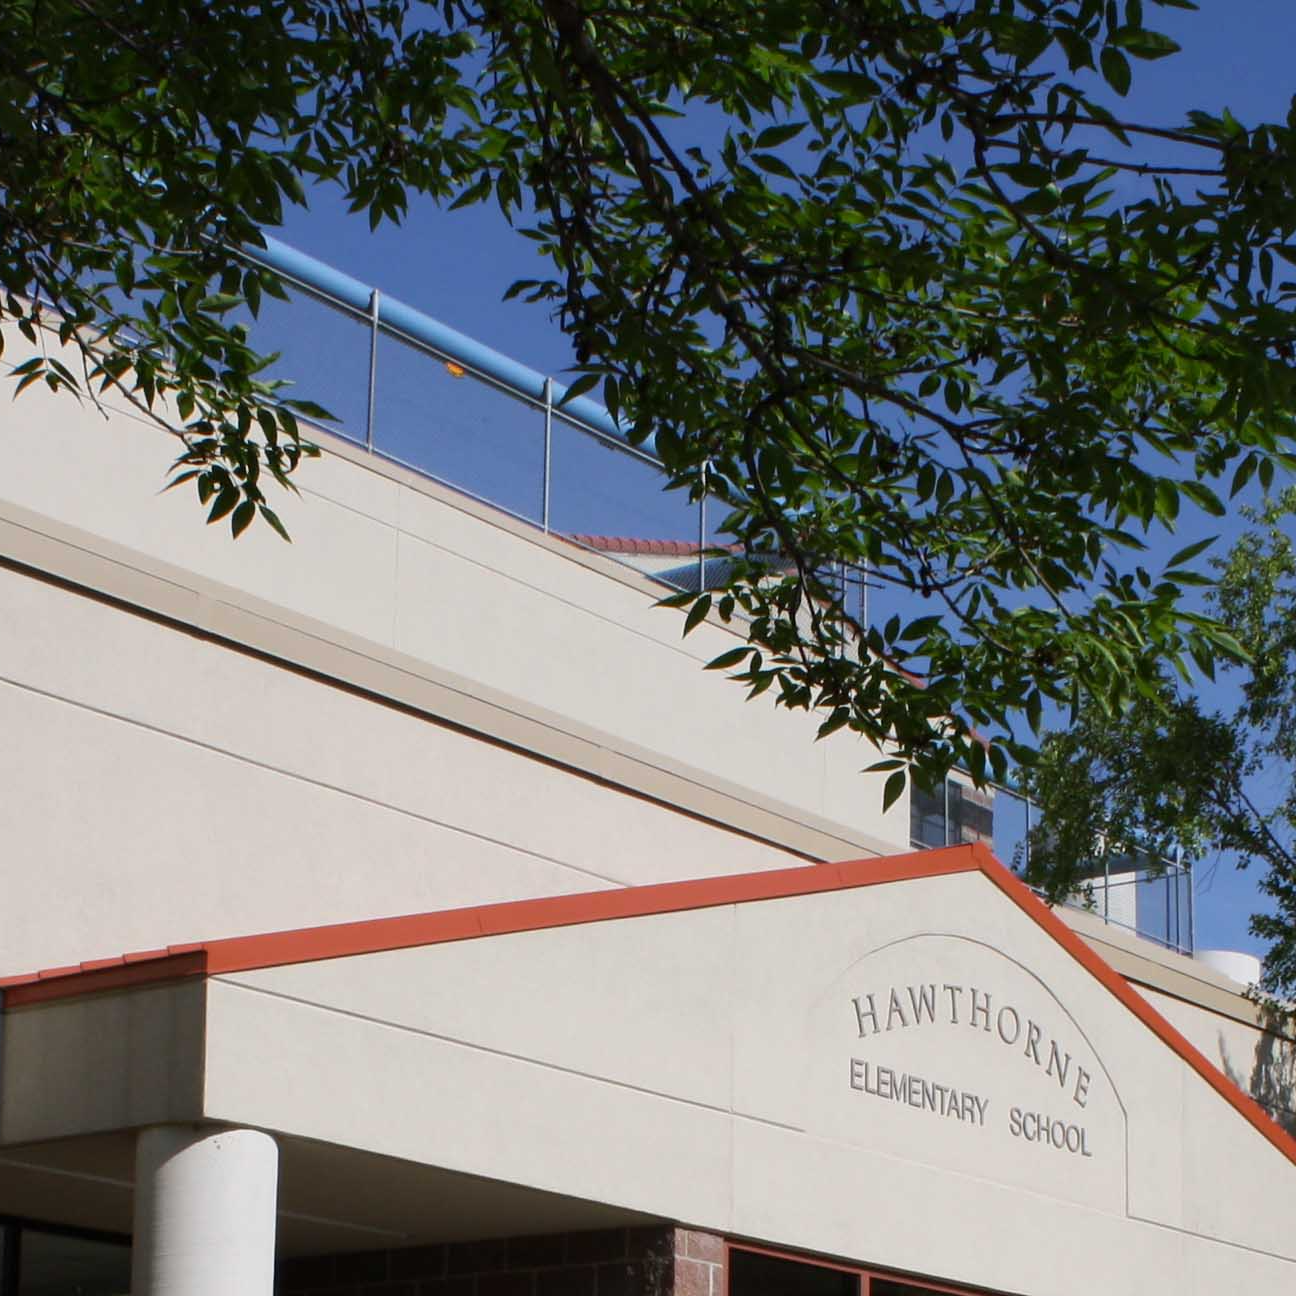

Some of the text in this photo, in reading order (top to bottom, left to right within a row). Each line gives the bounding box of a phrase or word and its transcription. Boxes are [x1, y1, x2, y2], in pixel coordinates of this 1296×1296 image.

[851, 983, 1091, 1109] HAWTHORNE
[849, 1057, 1092, 1157] ELEMENTARY SCHOOL
